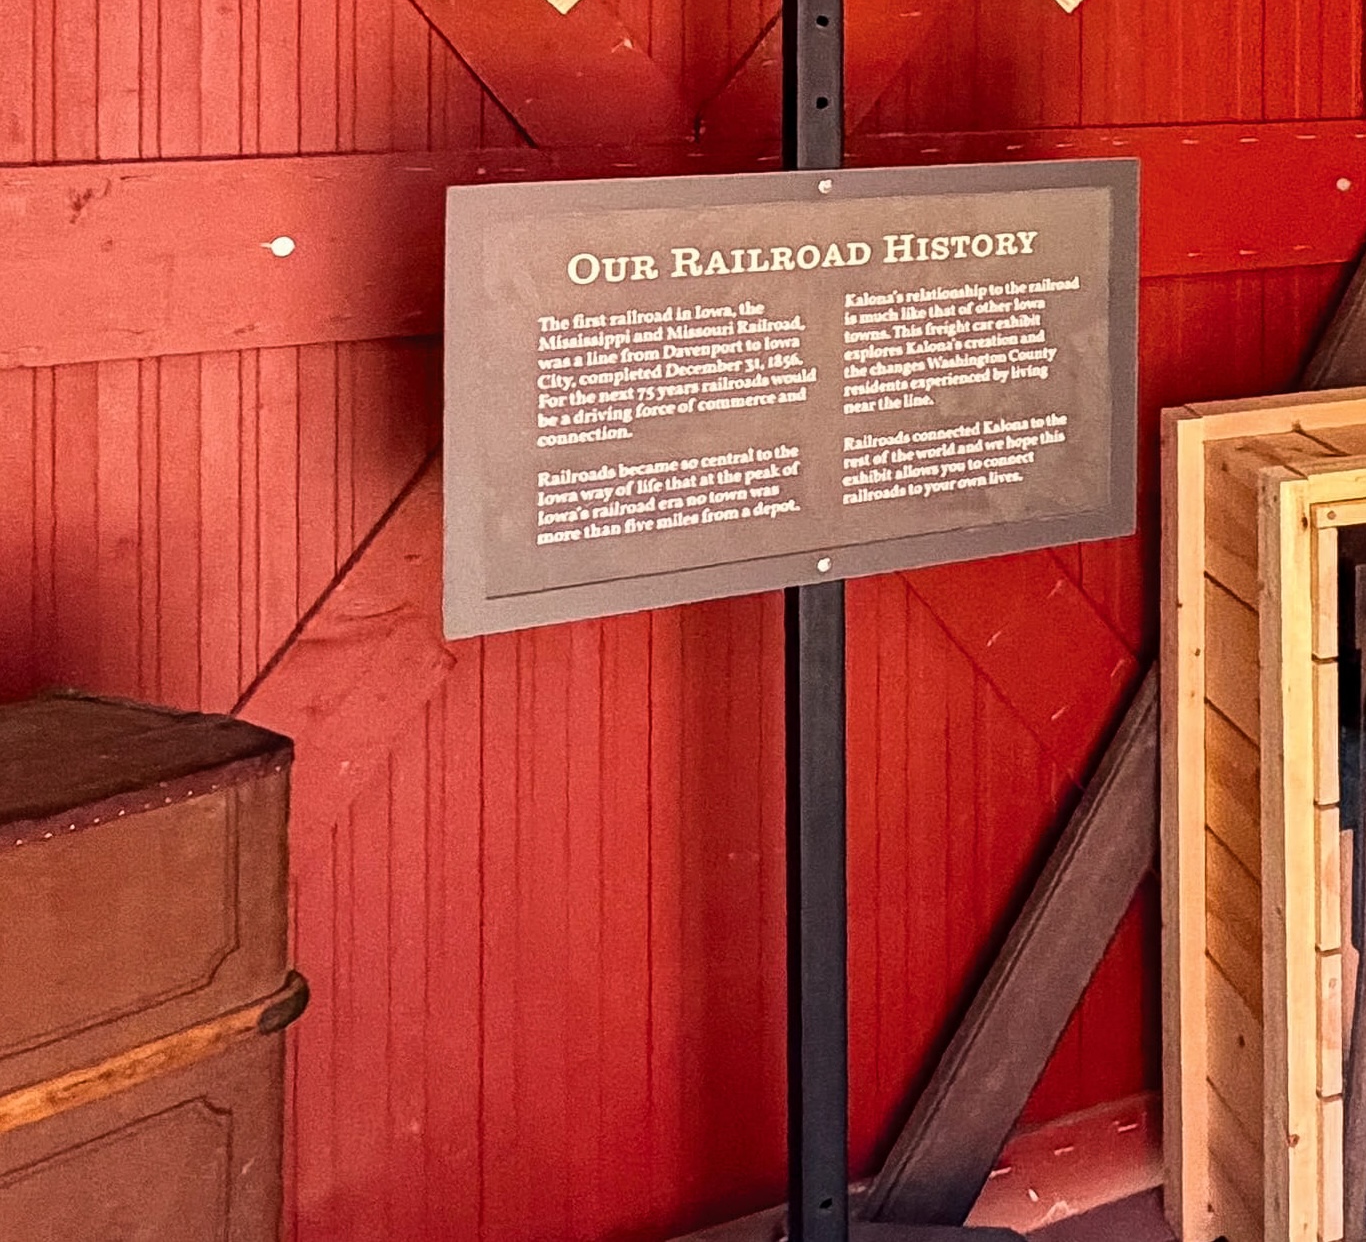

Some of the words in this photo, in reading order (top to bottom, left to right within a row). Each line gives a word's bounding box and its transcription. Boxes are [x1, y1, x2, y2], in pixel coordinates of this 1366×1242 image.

[537, 316, 569, 331] The
[572, 313, 606, 329] first
[609, 306, 672, 326] railroad
[675, 306, 691, 320] in
[738, 300, 764, 315] the
[537, 328, 630, 351] Mississippi
[632, 326, 663, 342] and
[666, 320, 734, 340] Missouri
[537, 356, 571, 369] was
[573, 355, 583, 367] a
[586, 350, 618, 366] line
[620, 347, 659, 363] from
[661, 339, 743, 359] Davenport
[745, 339, 761, 351] to
[764, 336, 799, 350] Iowa
[538, 393, 567, 409] For
[568, 389, 596, 405] the
[598, 387, 634, 403] next
[636, 386, 654, 400] 75
[656, 382, 699, 400] years
[701, 372, 769, 392] railroads
[770, 367, 816, 385] would
[578, 363, 662, 386] completed
[665, 358, 742, 377] December
[537, 412, 558, 427] be
[560, 414, 570, 425] a
[572, 405, 633, 424] driving
[635, 402, 675, 418] force
[677, 397, 696, 413] of
[697, 393, 776, 411] commerce
[777, 386, 806, 403] and
[536, 491, 578, 506] Iowa
[579, 487, 613, 502] way
[614, 480, 634, 496] of
[636, 477, 662, 494] life
[665, 474, 696, 490] that
[699, 473, 714, 486] at
[716, 469, 742, 484] the
[744, 463, 780, 485] peak
[781, 460, 800, 476] of
[537, 465, 616, 487] Railroads
[618, 460, 678, 477] became
[680, 458, 698, 470] so
[700, 447, 754, 467] central
[756, 449, 772, 461] to
[774, 444, 798, 458] the
[537, 505, 589, 526] Iowa's
[591, 496, 655, 518] railroad
[657, 497, 684, 510] era
[685, 494, 707, 506] no
[708, 489, 747, 503] town
[749, 485, 779, 497] was
[536, 529, 581, 544] more
[583, 523, 621, 538] than
[624, 517, 654, 533] five
[655, 511, 698, 529] miles
[701, 508, 739, 523] from
[741, 507, 750, 517] a
